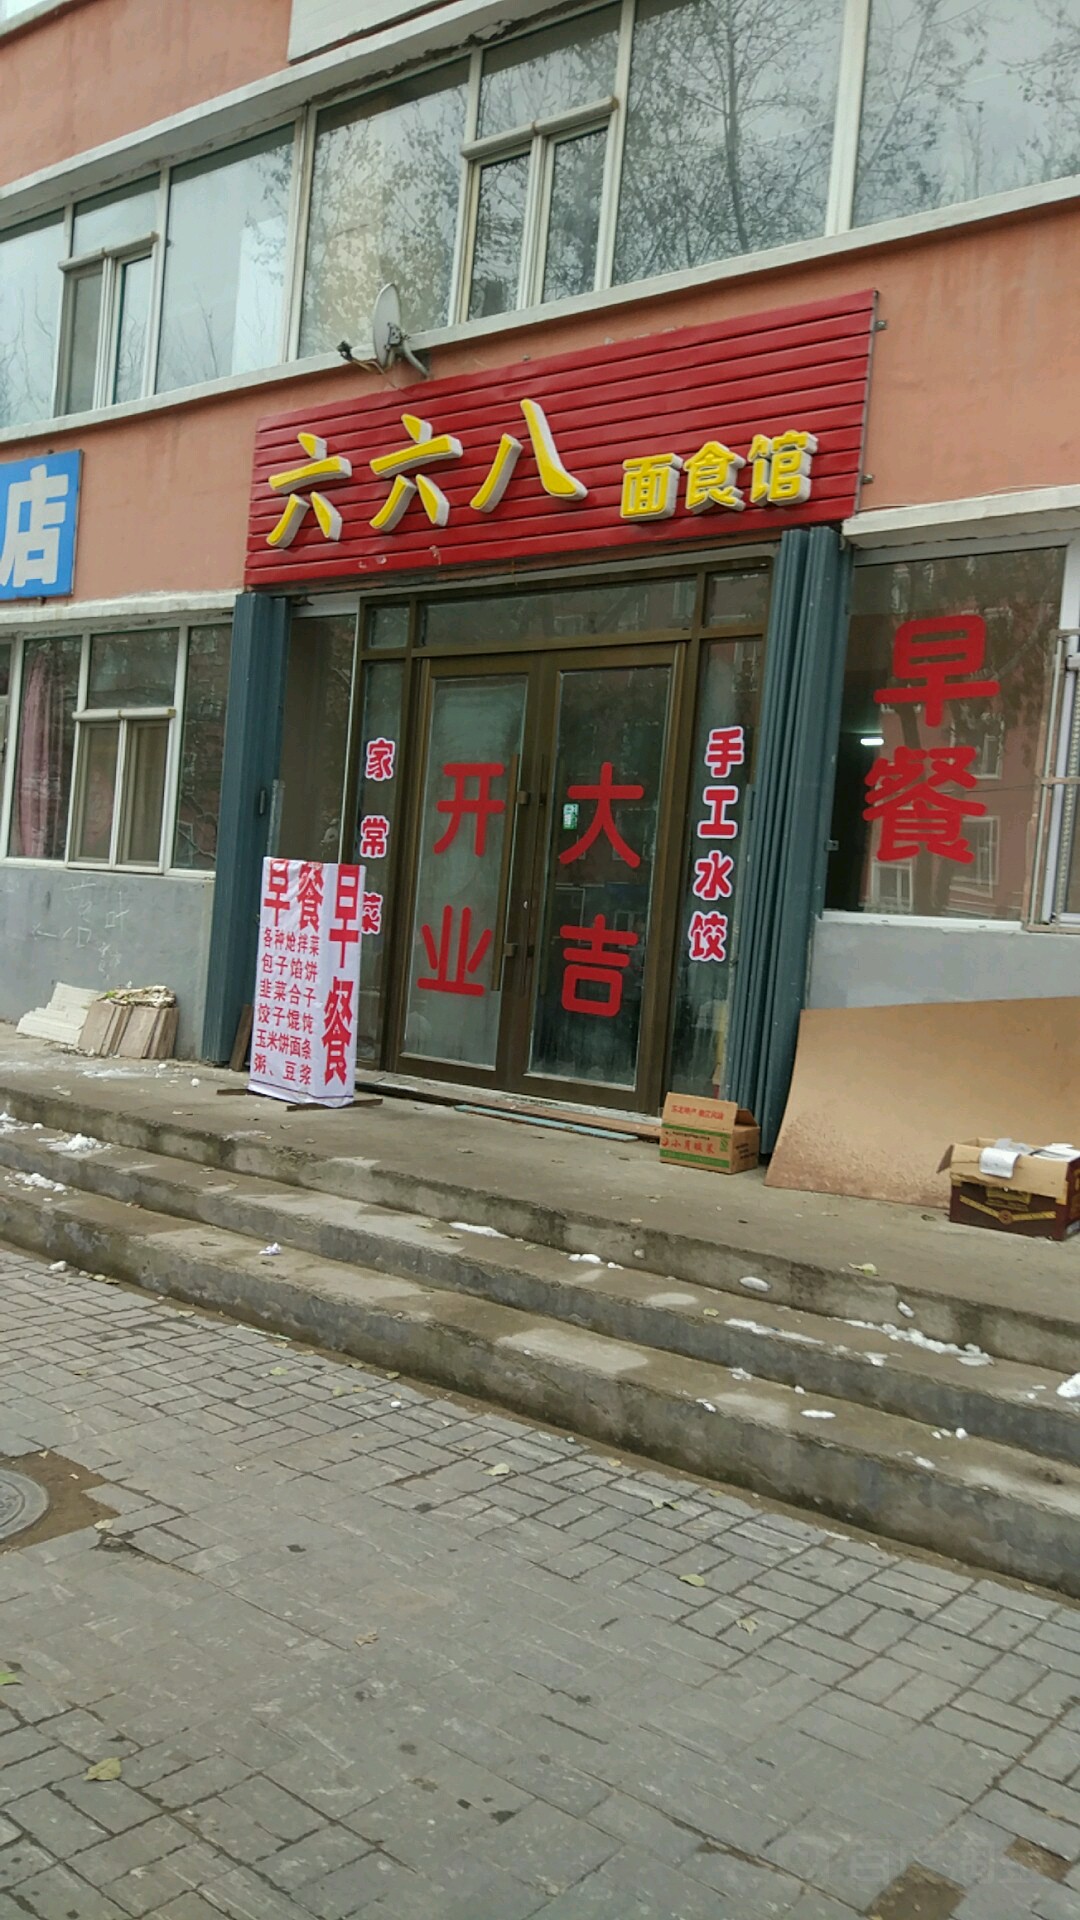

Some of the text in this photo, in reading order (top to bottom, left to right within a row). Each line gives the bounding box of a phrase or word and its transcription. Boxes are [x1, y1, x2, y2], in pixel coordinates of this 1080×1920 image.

[0, 463, 69, 588] 店
[266, 399, 819, 548] 六六八 面食馆
[862, 614, 1000, 864] 早餐
[264, 858, 324, 933] 早餐
[359, 737, 396, 935] 家常菜
[417, 762, 505, 997] 开业
[559, 761, 645, 1017] 大吉
[688, 726, 744, 962] 手工水饺
[257, 1003, 314, 1035] 饺子馄饨
[259, 978, 317, 1008] 韭菜合子
[261, 953, 319, 984] 包子馅饼
[321, 864, 360, 1086] 早餐
[255, 1028, 312, 1061] 玉米饼面条
